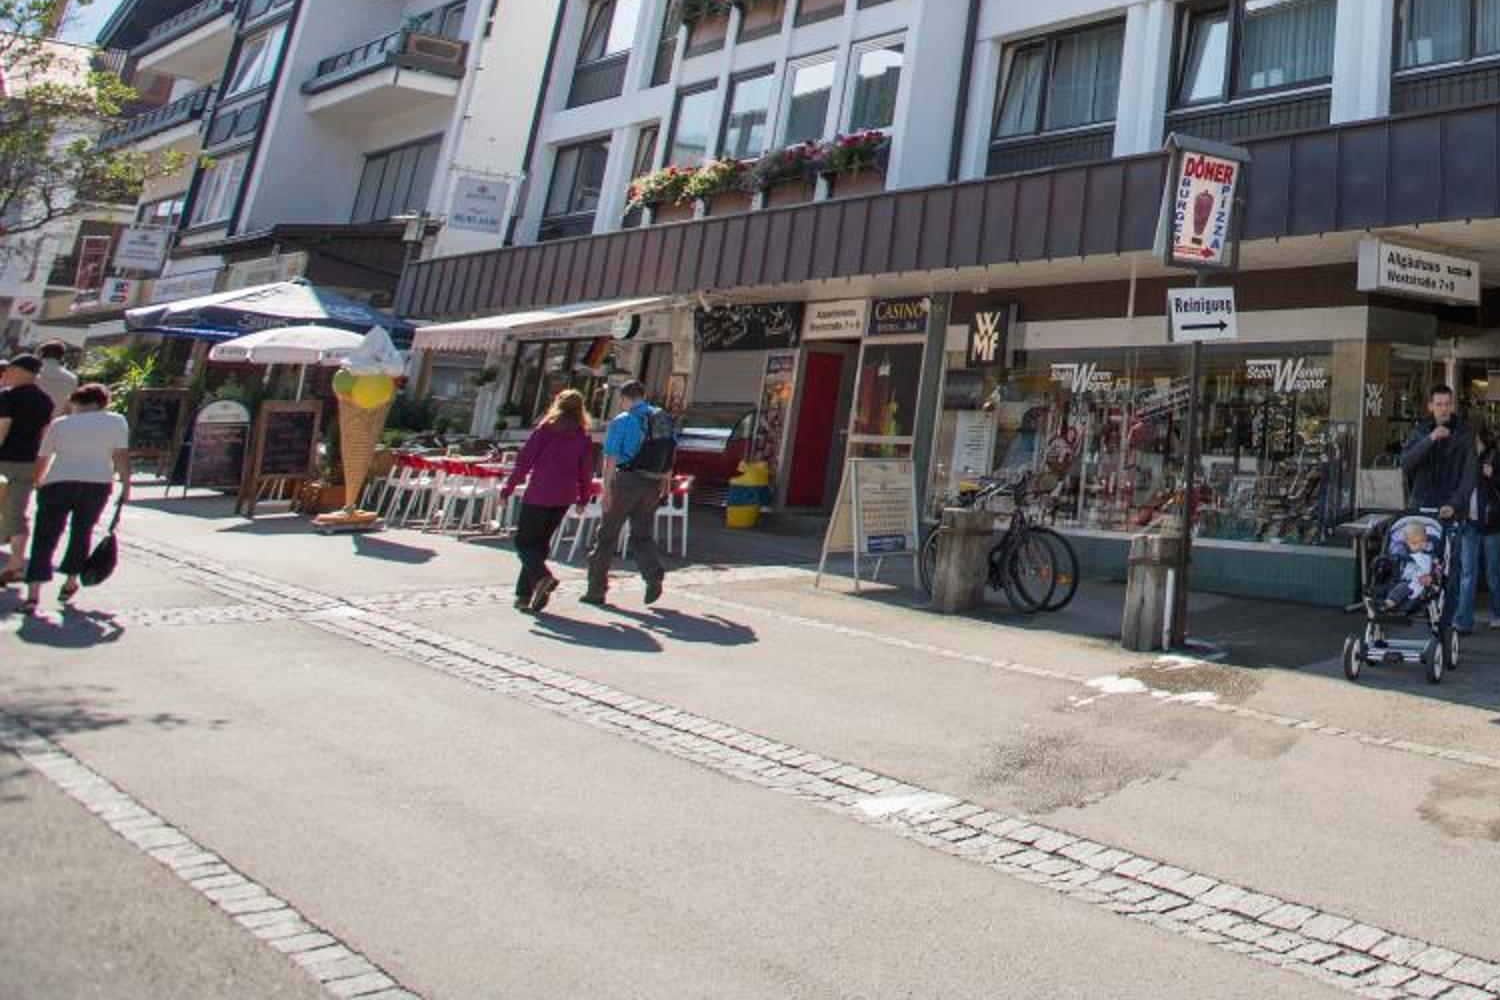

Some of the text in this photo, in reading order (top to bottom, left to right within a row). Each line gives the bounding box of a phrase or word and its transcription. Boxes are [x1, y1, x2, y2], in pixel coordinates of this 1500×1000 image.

[1184, 155, 1234, 184] DÖNER
[1210, 185, 1231, 249] PIZZA
[875, 301, 923, 322] CASINO
[1174, 297, 1233, 316] Reinigung
